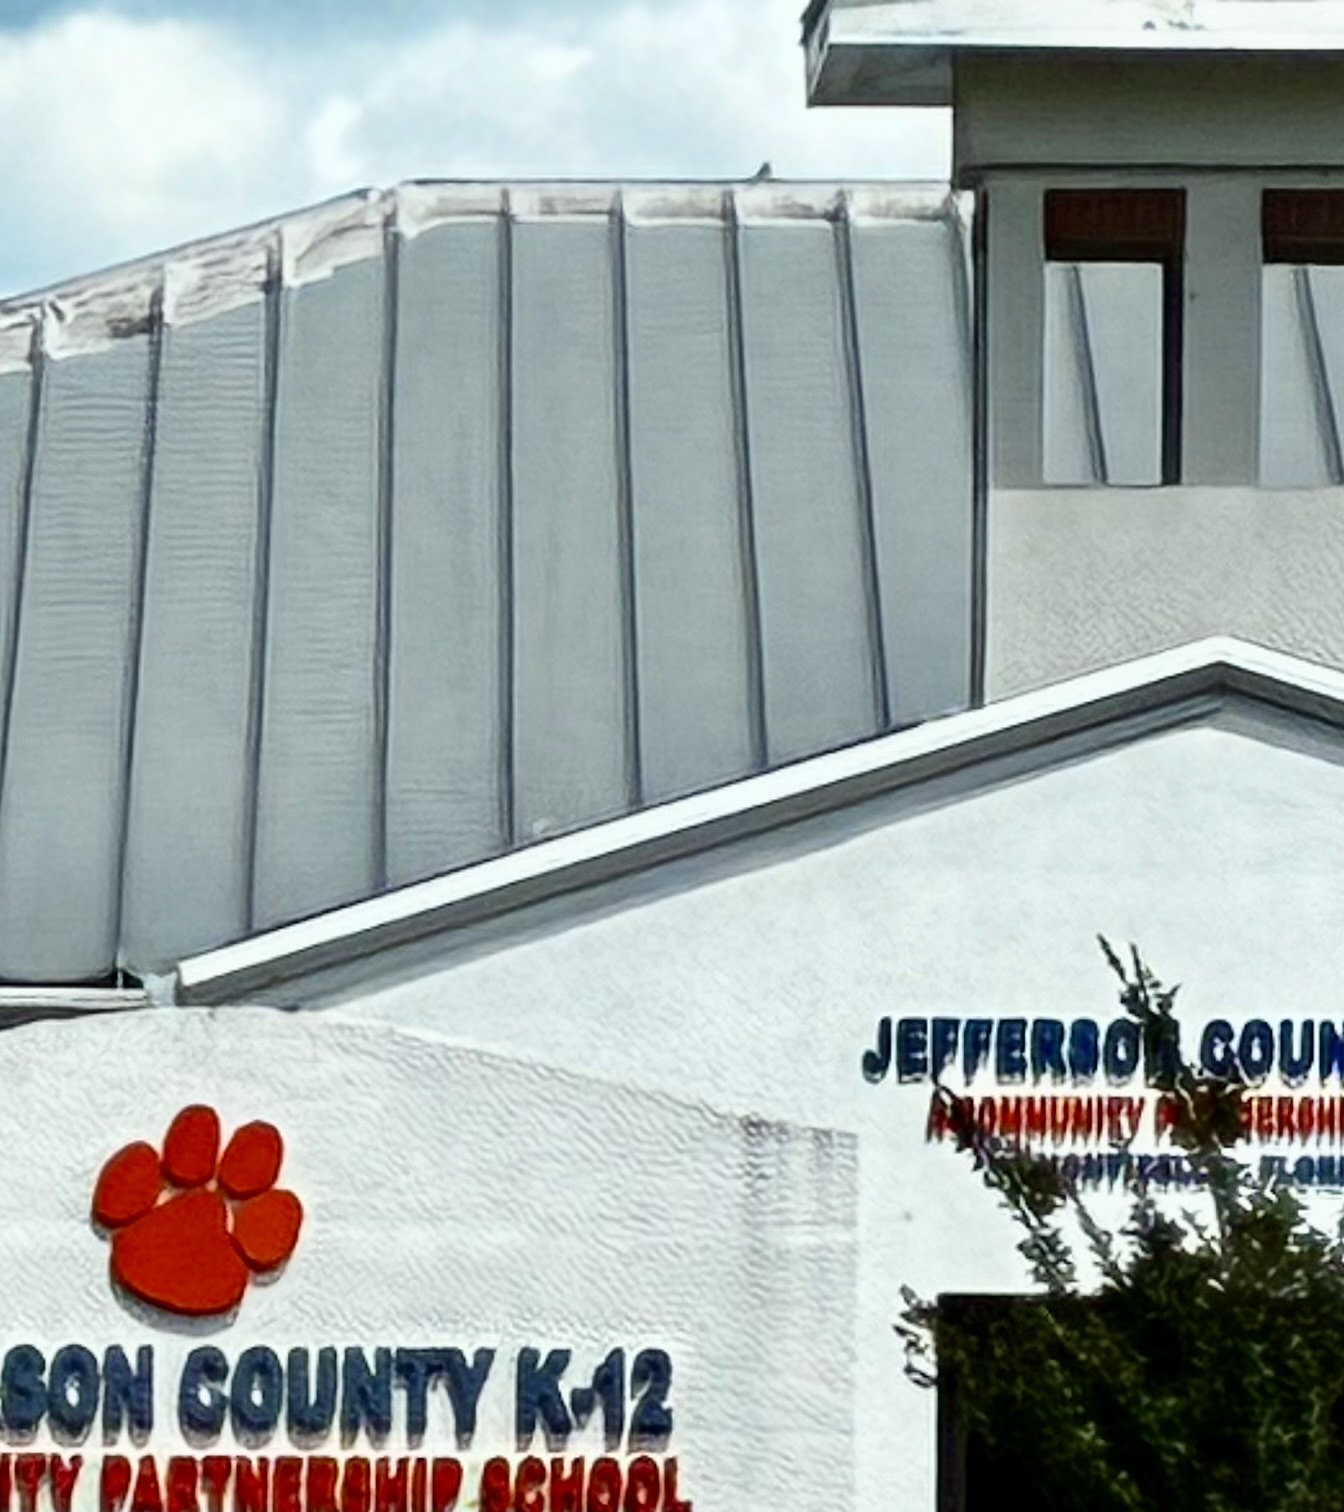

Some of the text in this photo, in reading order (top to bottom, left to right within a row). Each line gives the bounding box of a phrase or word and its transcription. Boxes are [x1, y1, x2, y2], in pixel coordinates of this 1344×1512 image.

[862, 1017, 1180, 1087] JEFFERSO
[178, 1345, 496, 1451] COUNTY
[516, 1347, 674, 1452] K-12
